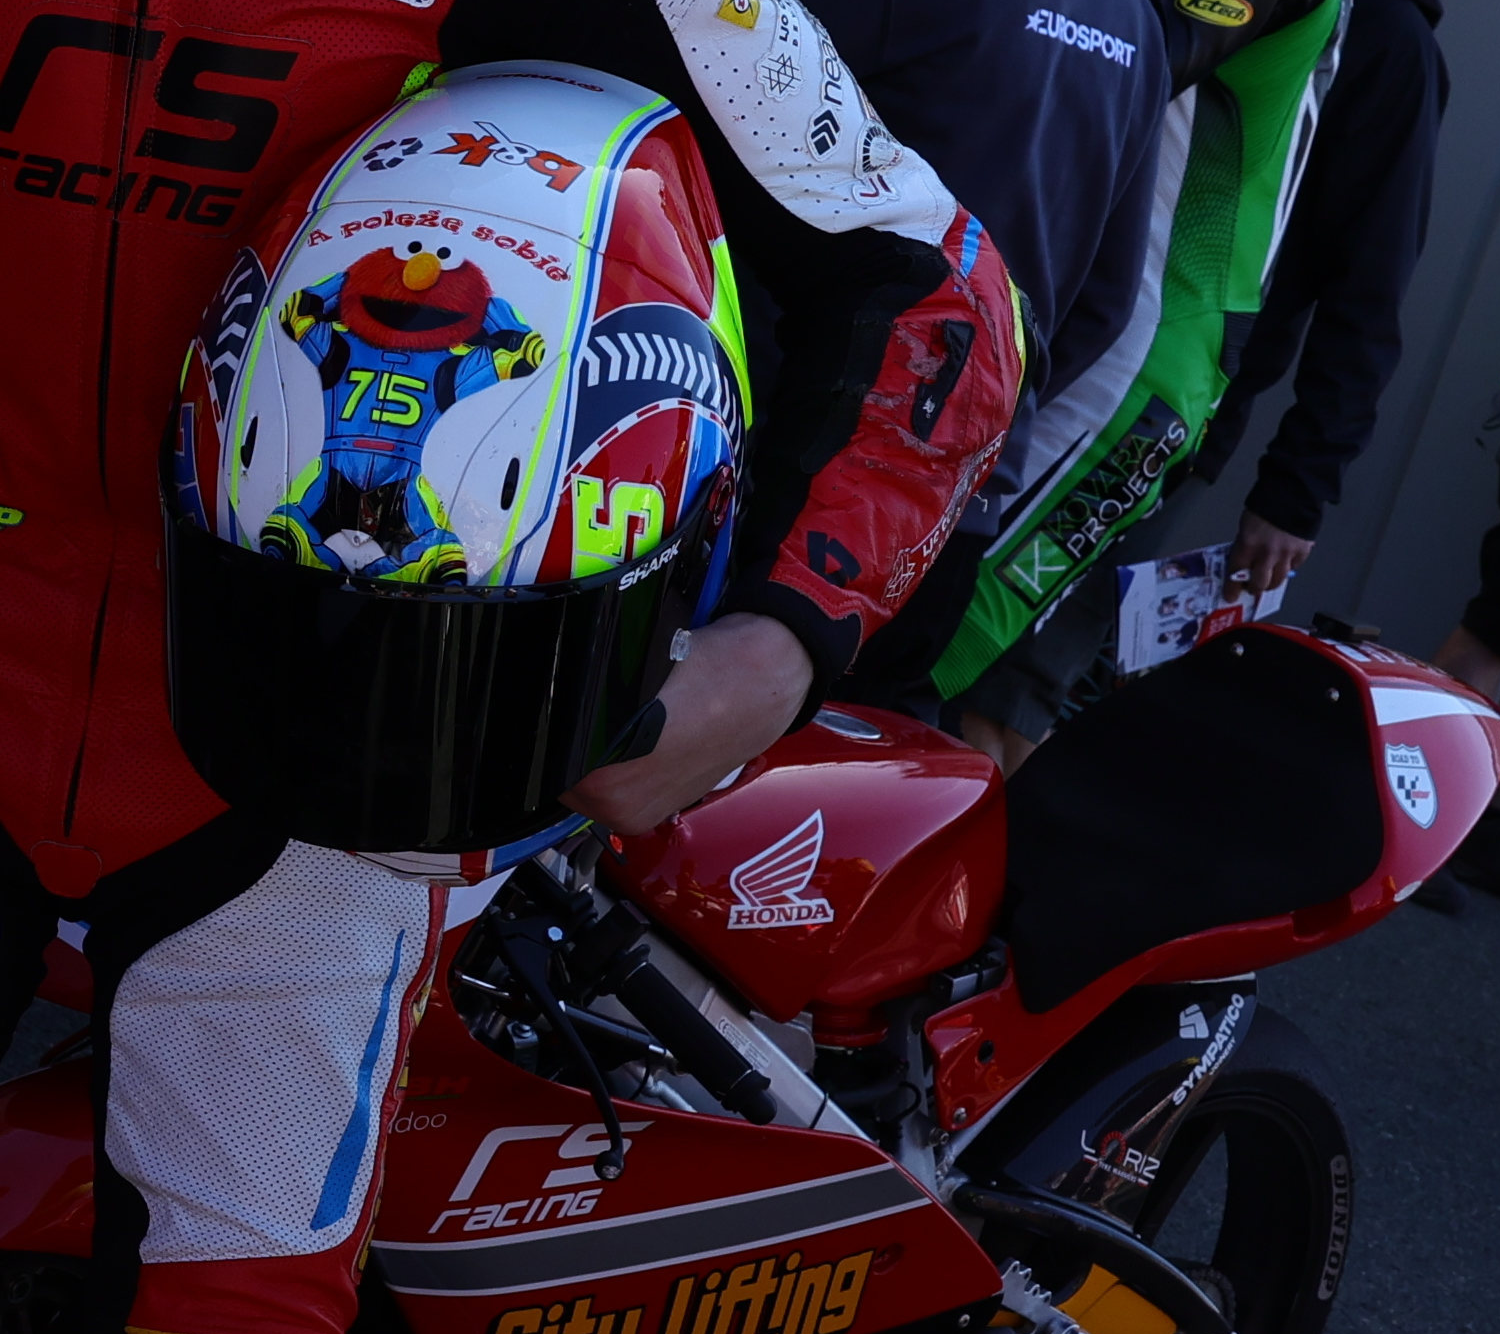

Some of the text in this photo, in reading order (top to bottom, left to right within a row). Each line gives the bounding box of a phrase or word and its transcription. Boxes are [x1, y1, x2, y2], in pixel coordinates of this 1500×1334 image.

[1037, 9, 1136, 68] EUROSPORT
[308, 228, 332, 246] A
[348, 368, 429, 426] 75
[1066, 419, 1186, 560] PROJECTS
[618, 538, 683, 592] SHARK
[734, 903, 829, 926] HONDA
[1172, 993, 1245, 1106] SYMPATICO
[1320, 1173, 1348, 1293] DUNLOP
